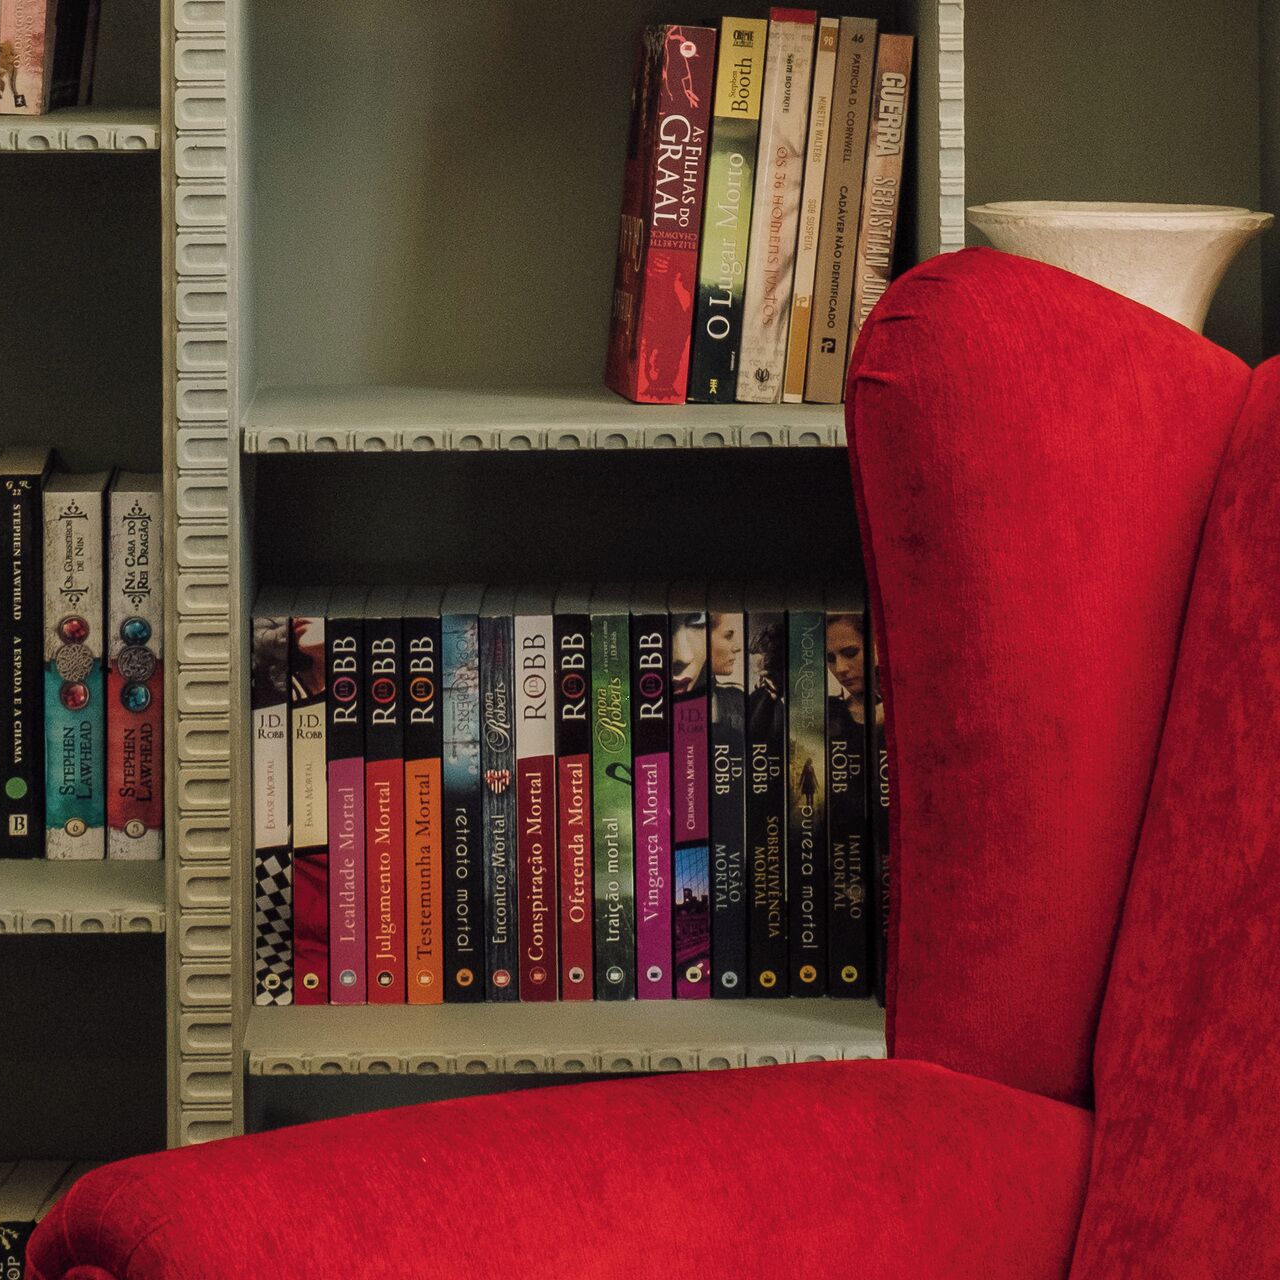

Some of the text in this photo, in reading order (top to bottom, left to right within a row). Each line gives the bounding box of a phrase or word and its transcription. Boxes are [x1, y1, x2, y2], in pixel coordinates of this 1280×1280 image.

[653, 114, 691, 226] GRAAL
[731, 57, 752, 114] Booth
[707, 153, 744, 339] O Lugar Morto
[375, 779, 396, 962] Julgamento Mortal
[416, 774, 432, 959] Testemunha Mortal
[527, 772, 546, 962] Conspiração Mortal
